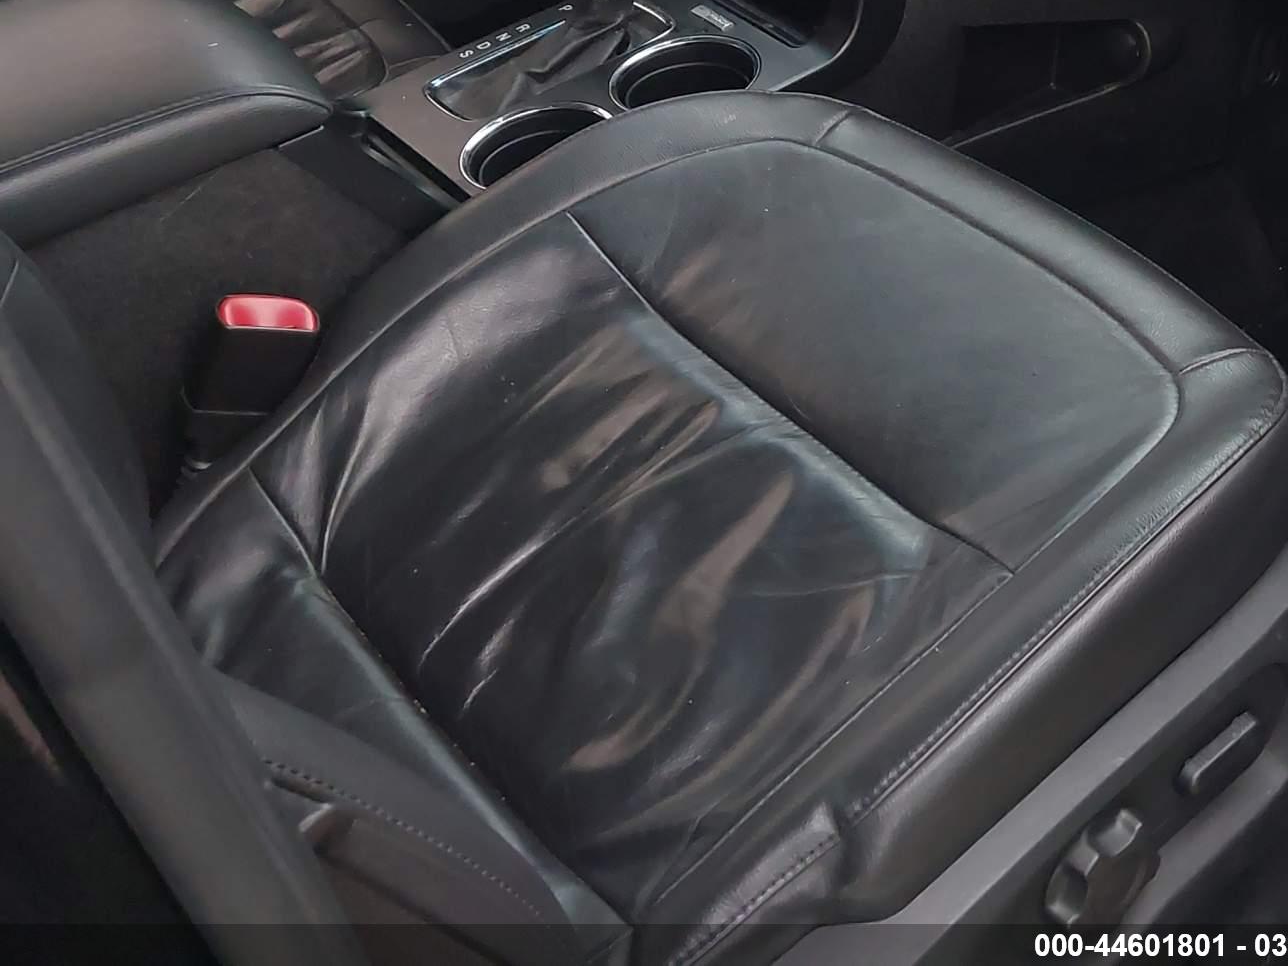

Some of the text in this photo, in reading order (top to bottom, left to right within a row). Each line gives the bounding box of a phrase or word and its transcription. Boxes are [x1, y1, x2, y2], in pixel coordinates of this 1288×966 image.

[516, 23, 531, 33] R
[495, 32, 512, 42] N
[476, 41, 492, 50] D
[460, 49, 474, 59] S
